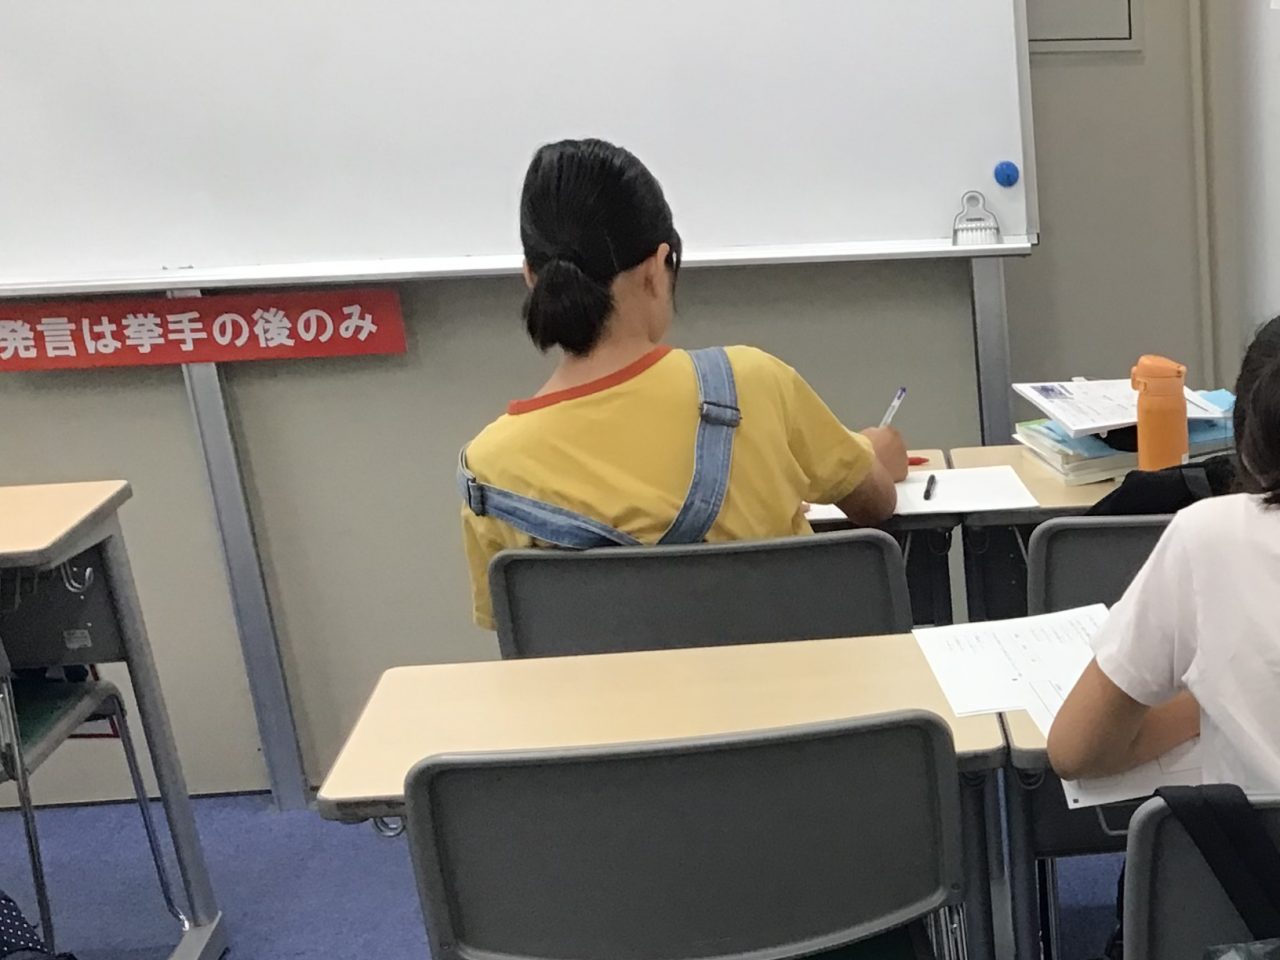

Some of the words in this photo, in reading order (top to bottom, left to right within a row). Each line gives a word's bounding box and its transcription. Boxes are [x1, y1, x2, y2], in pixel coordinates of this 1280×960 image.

[0, 305, 378, 359] 発言は挙手の後のみ
